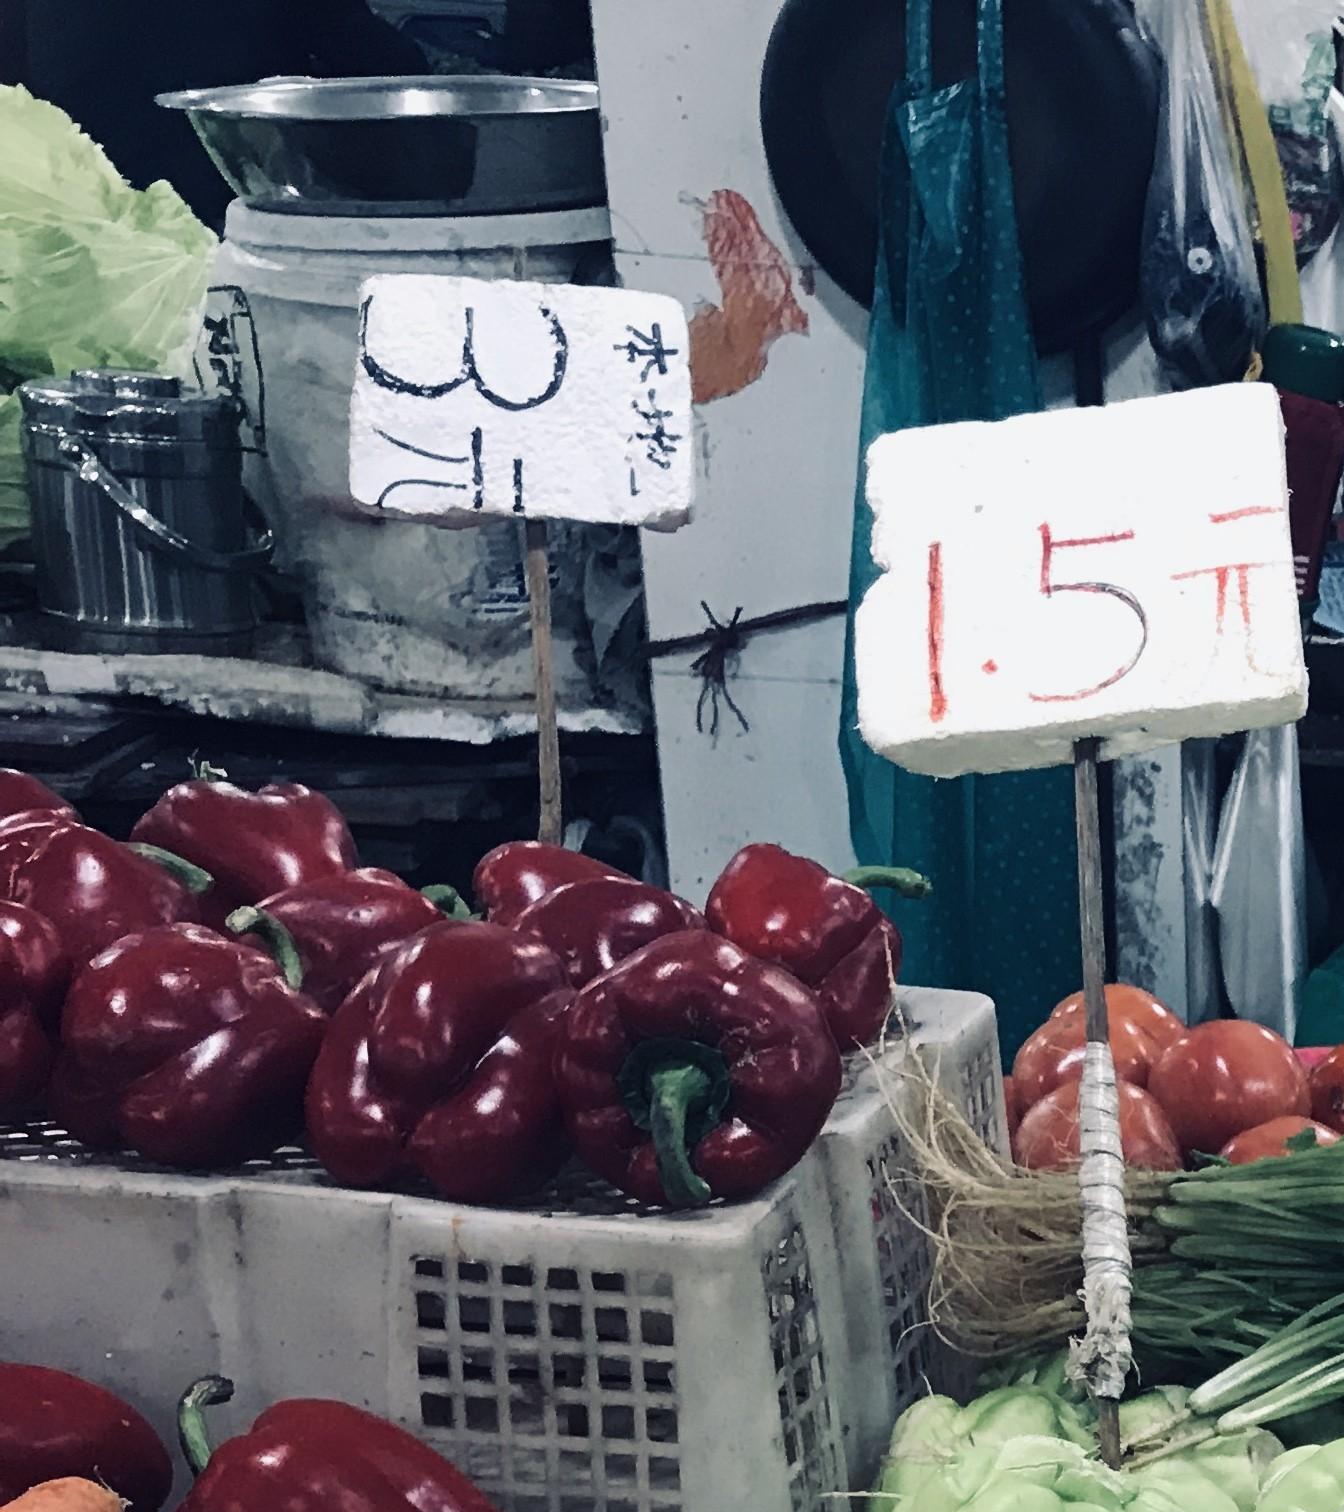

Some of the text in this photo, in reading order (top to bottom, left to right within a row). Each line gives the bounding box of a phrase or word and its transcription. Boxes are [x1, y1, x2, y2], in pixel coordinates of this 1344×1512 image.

[357, 294, 569, 512] 3元
[612, 322, 684, 496] 本地
[927, 505, 1300, 723] 1.5元
